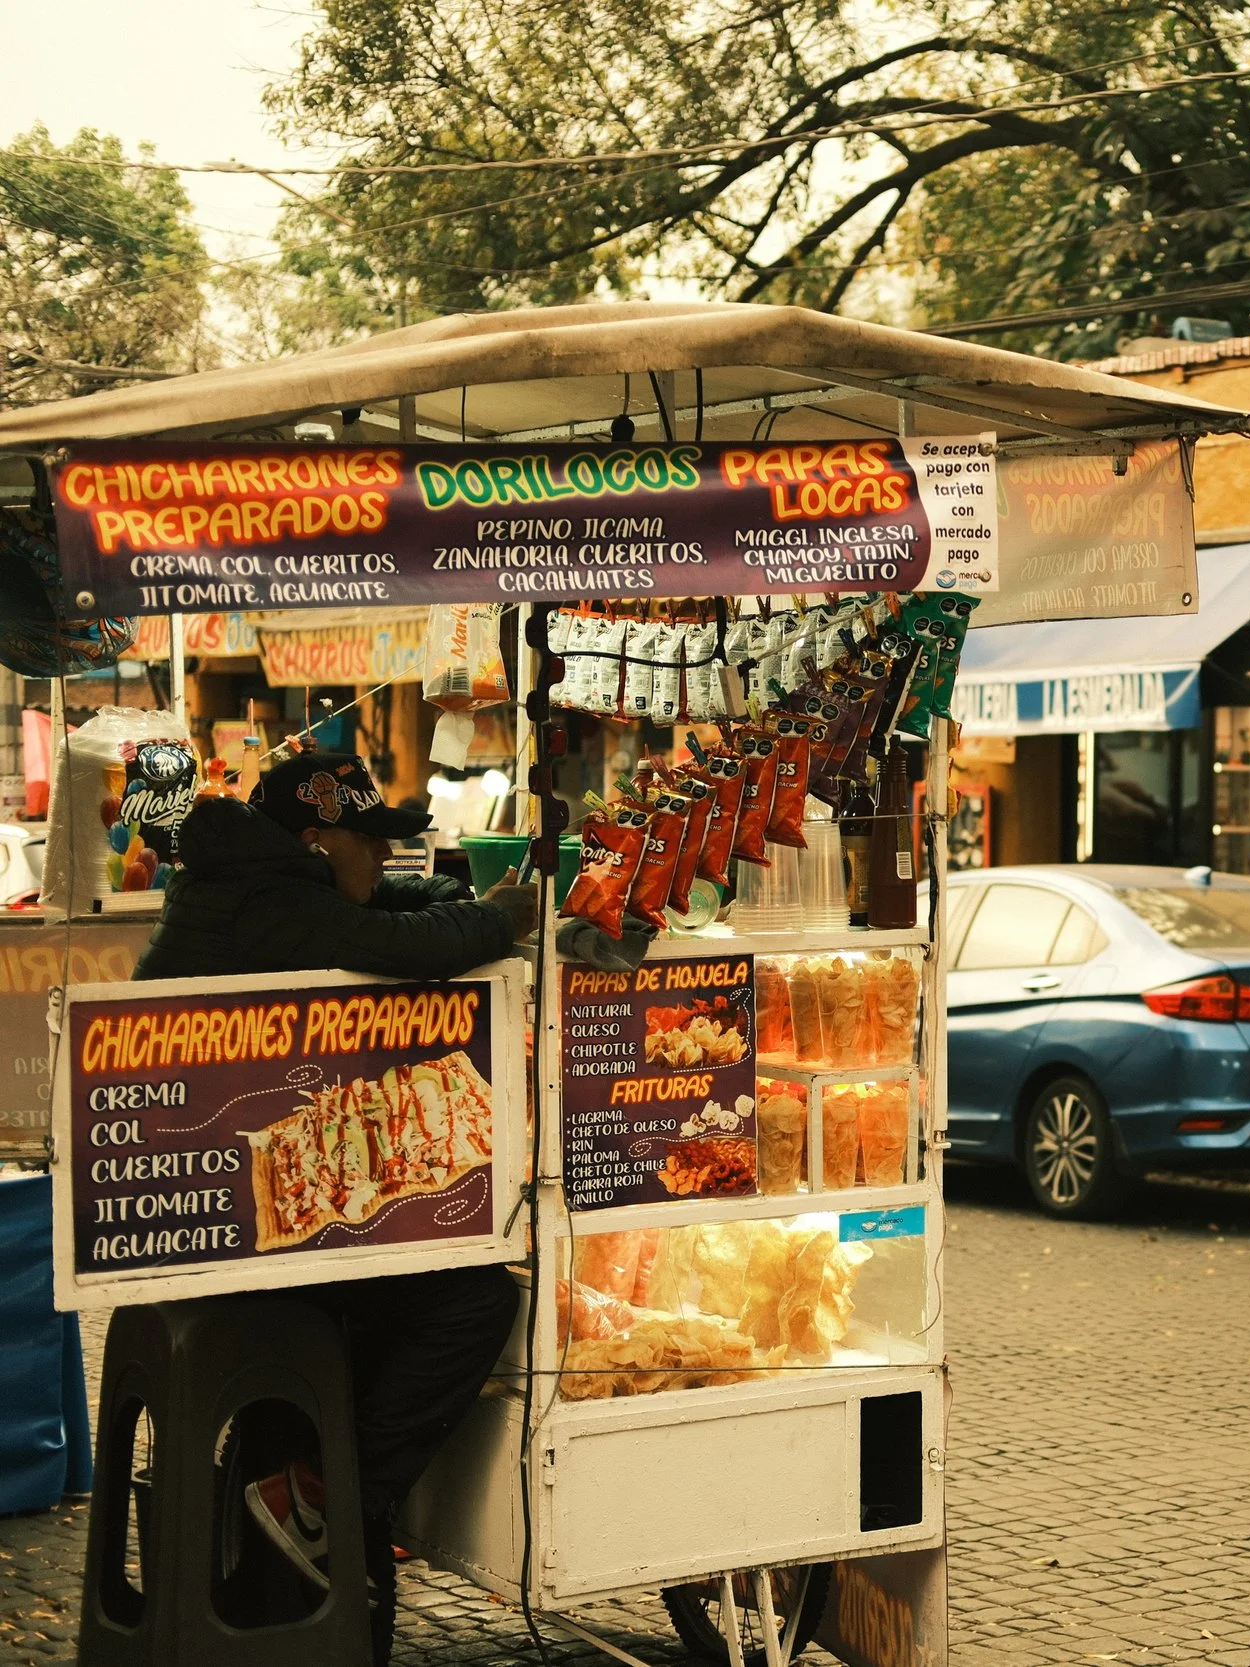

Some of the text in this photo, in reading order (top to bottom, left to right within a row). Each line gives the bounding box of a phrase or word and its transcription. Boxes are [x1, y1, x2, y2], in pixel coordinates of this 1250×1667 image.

[922, 443, 984, 458] Se acept
[723, 443, 888, 487] PAPAS
[926, 462, 990, 477] pago con
[65, 451, 400, 506] CHICHARRONES
[416, 446, 701, 510] DORILOCOS
[775, 475, 905, 520] LOCAS
[934, 482, 984, 499] tarjeta
[96, 491, 386, 550] PREPARADOS
[952, 505, 974, 517] con
[477, 517, 666, 542] PEPINO, JICAMA,
[735, 523, 919, 548] MAGGI, INGLESA,
[935, 525, 991, 539] mercado
[274, 553, 400, 575] CUERITOS,
[432, 541, 708, 571] ZANAHORIA, CUERITOS,
[743, 546, 847, 567] CHAMOY,
[948, 548, 979, 563] pago
[498, 568, 655, 593] CACAHUATES
[765, 562, 898, 584] MIGUELITO
[269, 581, 390, 602] AGUACATE
[570, 961, 749, 995] PAPAS DE HOJUELA
[571, 1003, 634, 1019] NATURAL
[81, 990, 481, 1074] CHICHARRONES PREPARADOS
[571, 1022, 621, 1038] QUESO
[571, 1042, 637, 1059] CHIPOTLE
[571, 1060, 636, 1077] ADOBADA
[88, 1081, 187, 1114] CREMA
[611, 1074, 715, 1105] FRITURAS
[571, 1109, 623, 1125] LAGRIMA
[90, 1120, 146, 1149] COL
[572, 1119, 677, 1139] CHETO DE QUESO
[572, 1138, 594, 1151] RIN
[90, 1148, 242, 1185] CUERITOS
[572, 1150, 620, 1166] PALOMA
[572, 1158, 667, 1179] CHETO DE CHILE
[572, 1174, 643, 1193] GARRA ROJA
[94, 1187, 234, 1225] JITOMATE
[572, 1190, 614, 1205] ANILLO
[92, 1223, 241, 1262] AGUACATE
